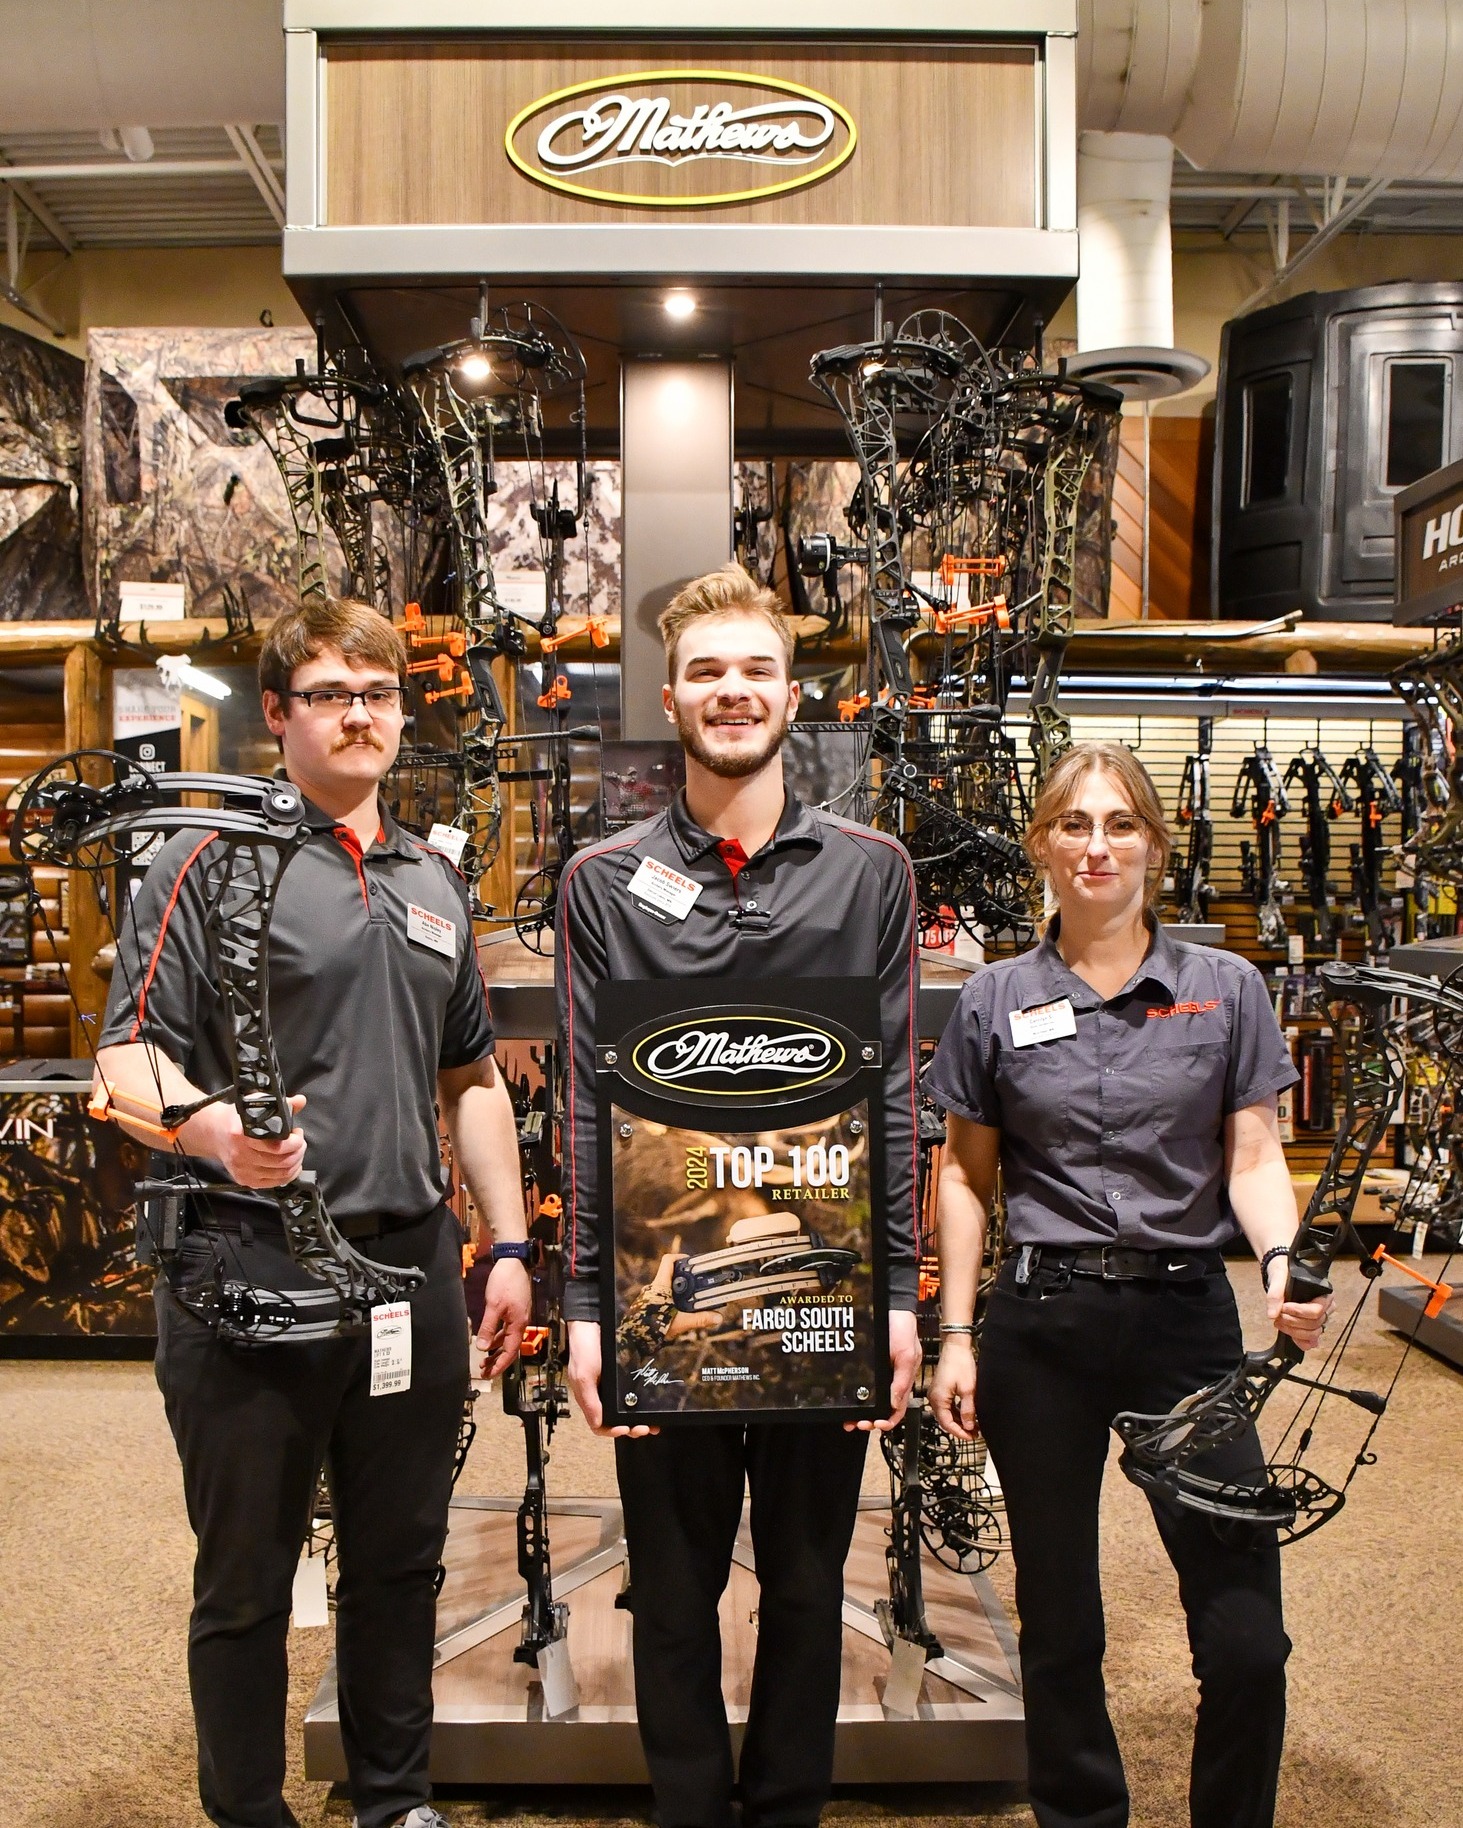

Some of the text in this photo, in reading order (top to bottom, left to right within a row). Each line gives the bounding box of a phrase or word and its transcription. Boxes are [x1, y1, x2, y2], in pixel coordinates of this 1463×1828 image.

[537, 94, 835, 167] Mathews
[645, 860, 696, 892] SCHEELS
[411, 907, 452, 931] SCHEELS
[1146, 998, 1222, 1019] SCHEELS
[647, 1030, 832, 1076] Mathews
[686, 1144, 850, 1190] 2024 TOP 100
[771, 1188, 850, 1201] RETAILER
[757, 1238, 799, 1248] LIFT
[766, 1281, 810, 1293] LIFT
[780, 1294, 853, 1305] AWARDED TO
[373, 1309, 410, 1322] SCHEELS
[742, 1306, 854, 1331] FARGO SOUTH
[781, 1330, 855, 1354] SCHEELS
[701, 1367, 717, 1375] MATT
[372, 1379, 402, 1391] $1,399.99
